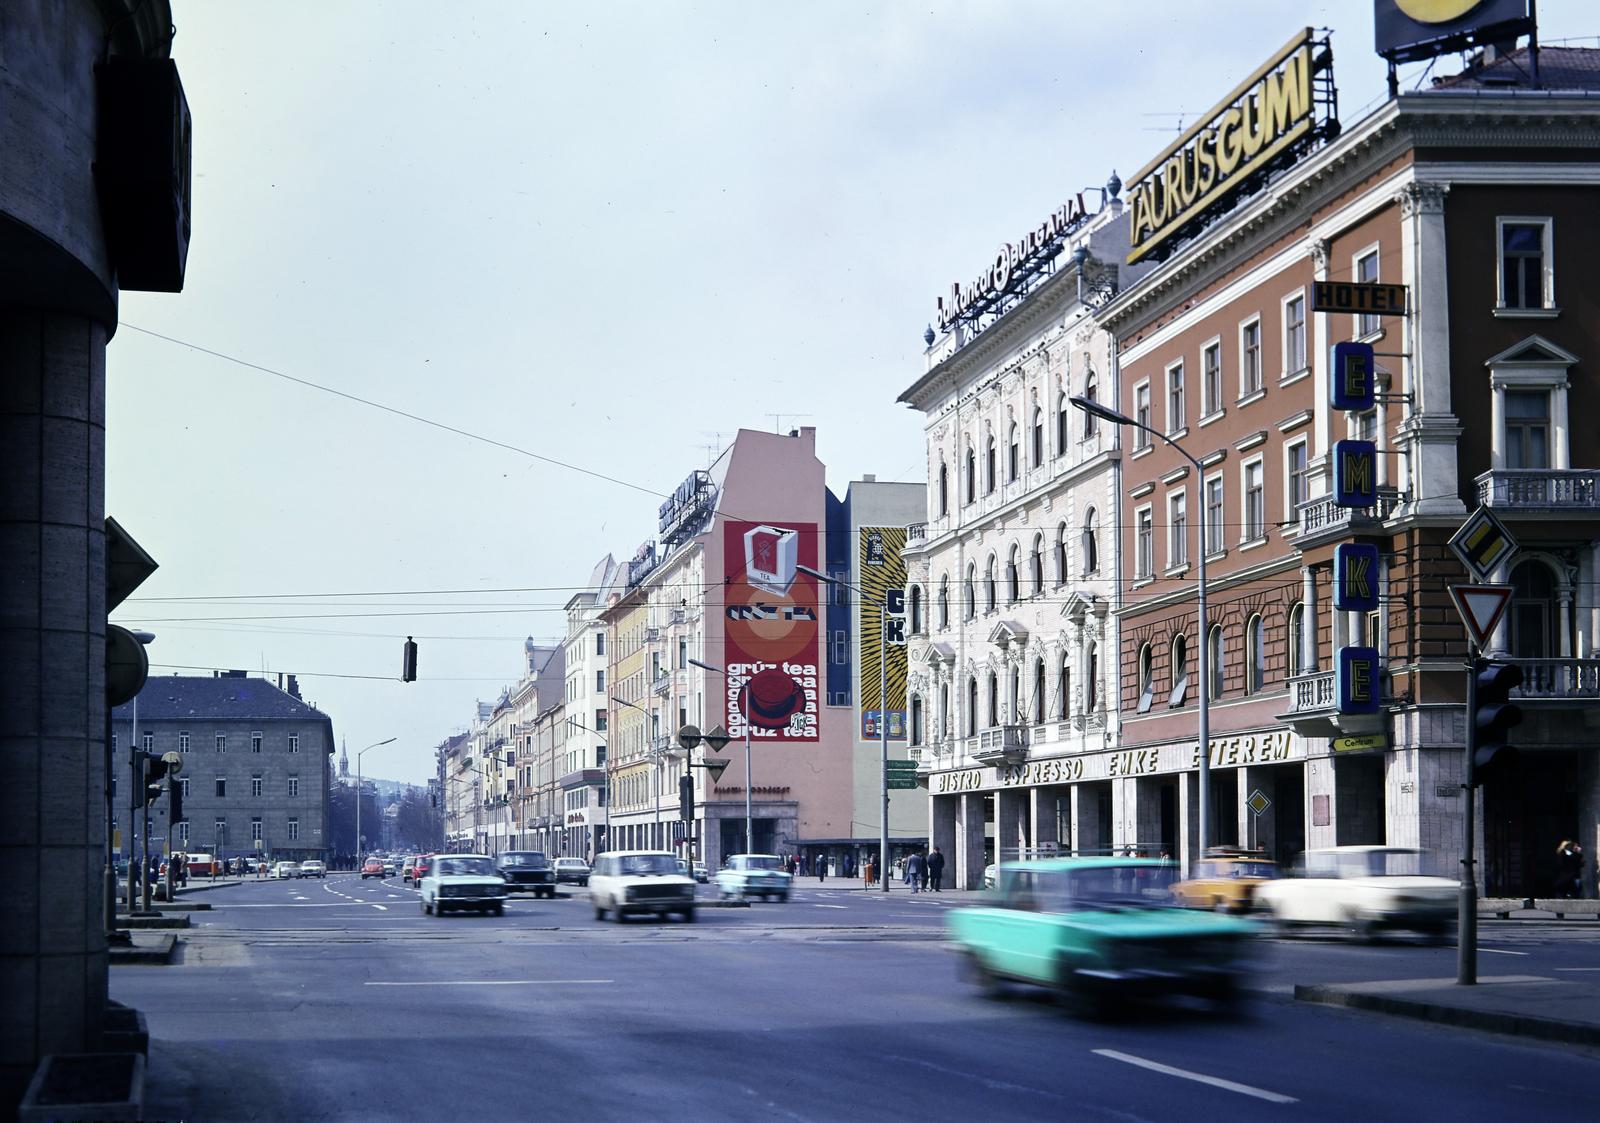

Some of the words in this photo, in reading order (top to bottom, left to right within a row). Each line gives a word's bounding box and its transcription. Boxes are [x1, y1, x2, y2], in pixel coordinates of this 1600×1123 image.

[1010, 193, 1086, 268] BULGARIA
[1316, 284, 1403, 312] HOTEL
[780, 606, 817, 620] TEA
[782, 661, 817, 675] tea
[1344, 738, 1374, 748] Centrum
[939, 770, 981, 792] BISTRO
[1003, 758, 1083, 786] ESPRESSO
[1109, 749, 1159, 776] EMKE
